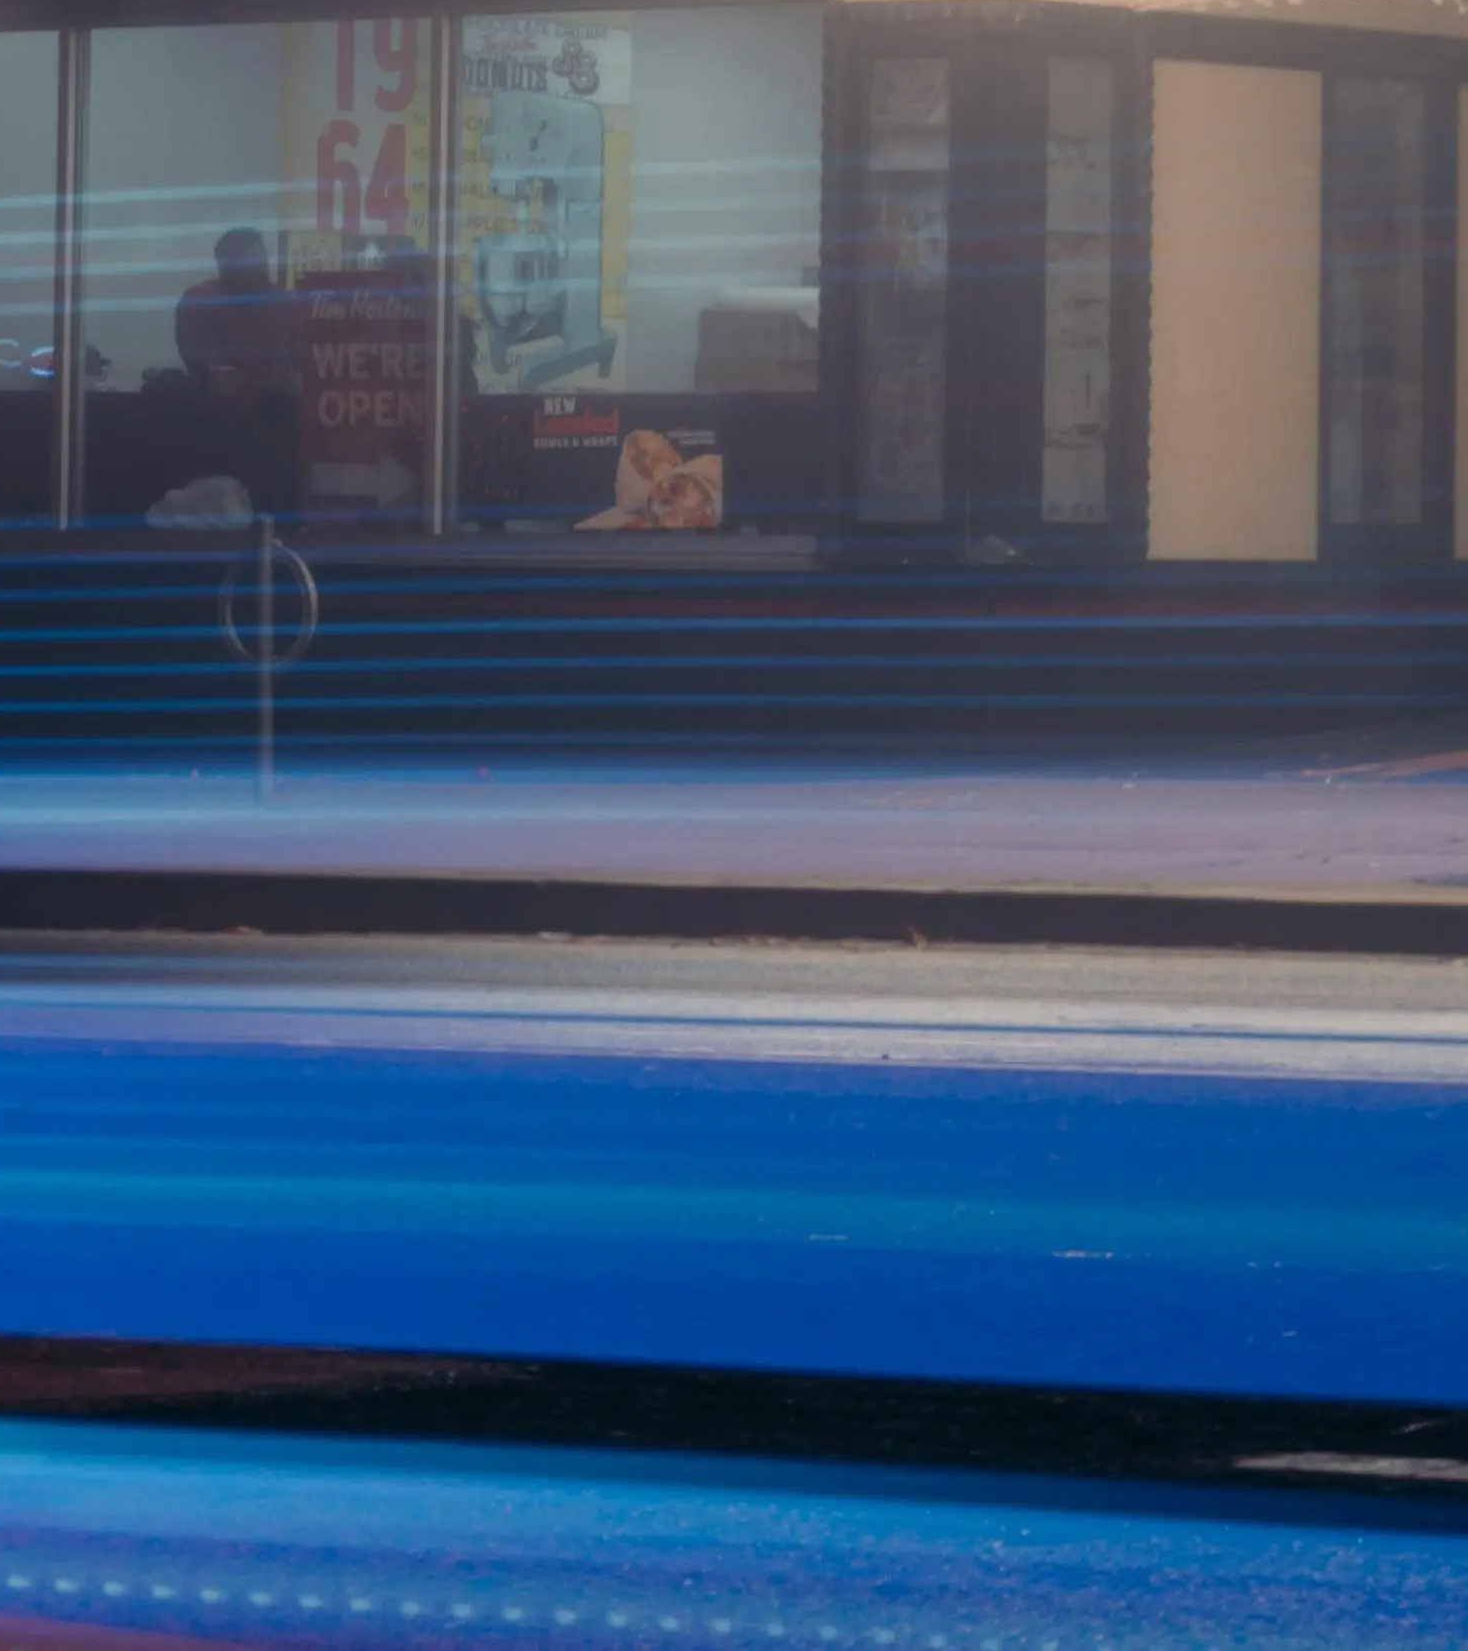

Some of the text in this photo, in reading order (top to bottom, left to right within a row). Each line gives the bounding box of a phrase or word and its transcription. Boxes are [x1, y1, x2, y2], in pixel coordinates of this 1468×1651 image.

[336, 17, 418, 113] 19
[316, 119, 410, 235] 64
[309, 289, 345, 320] Tim
[312, 341, 426, 381] WE'RE
[317, 389, 424, 427] OPEN
[544, 396, 576, 416] NEW
[582, 434, 619, 448] WRAPS
